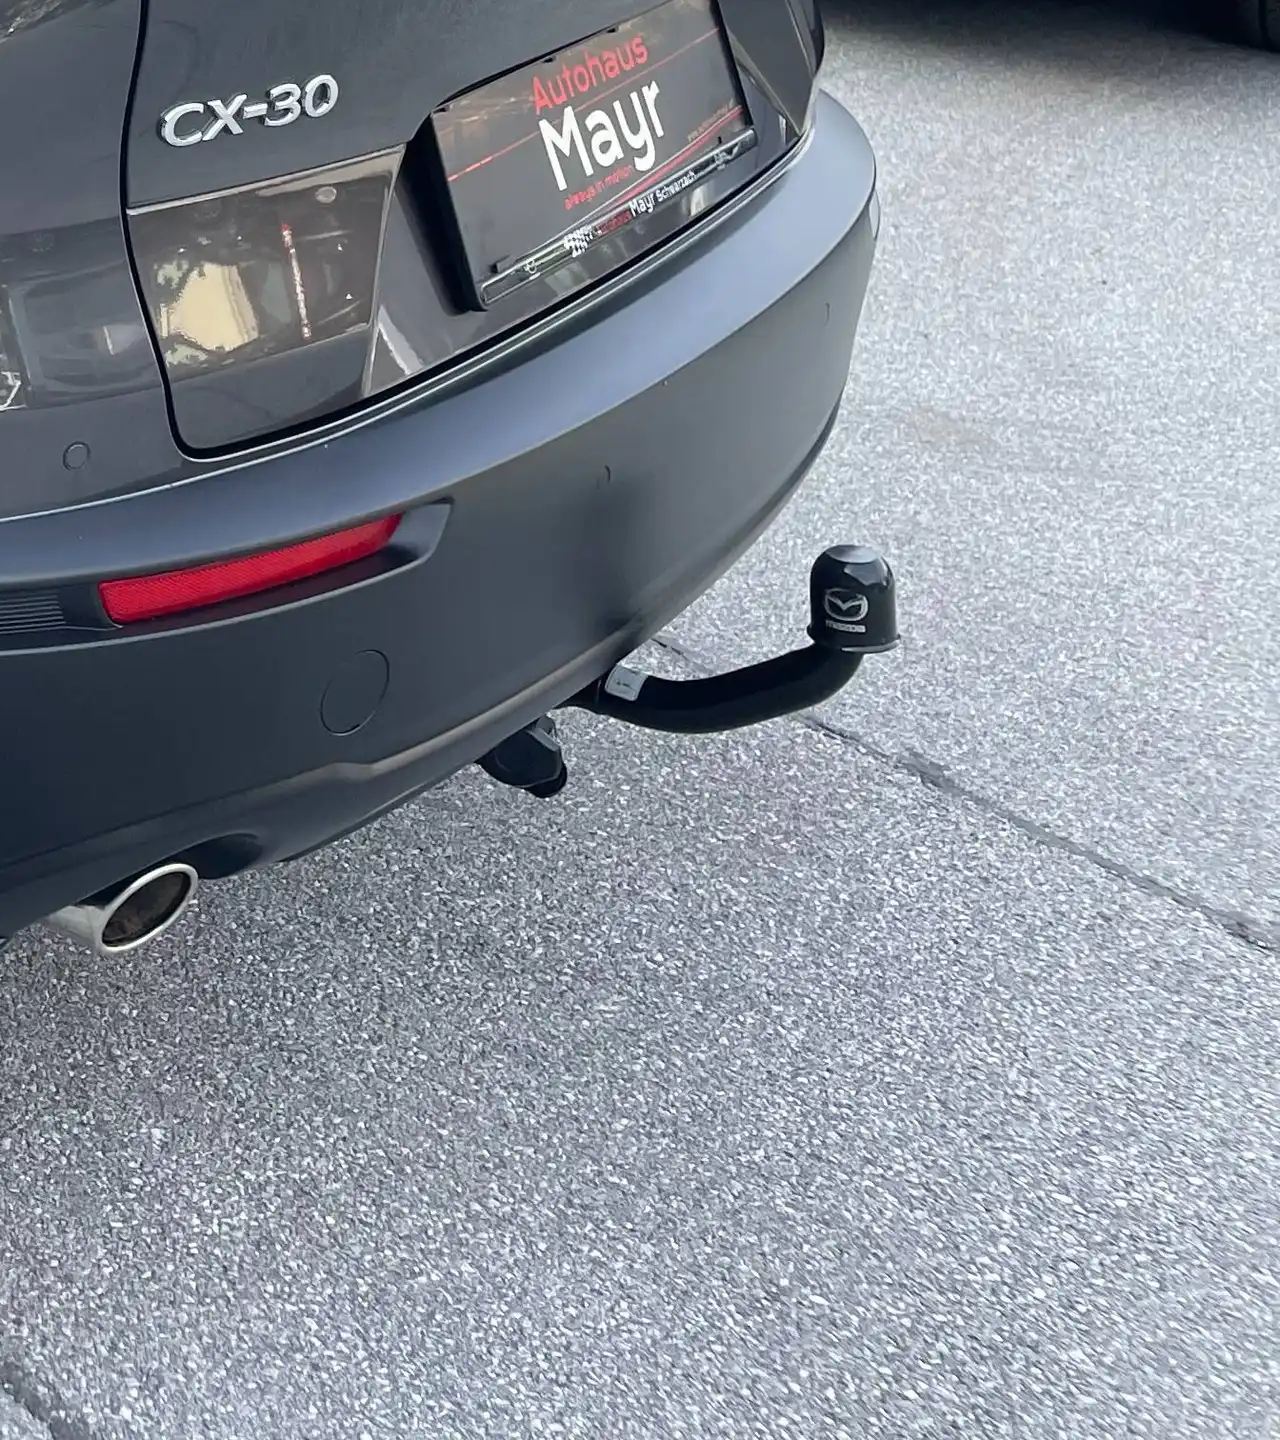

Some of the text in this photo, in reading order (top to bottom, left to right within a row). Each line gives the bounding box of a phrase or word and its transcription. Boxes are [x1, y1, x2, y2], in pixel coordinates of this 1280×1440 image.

[158, 73, 340, 148] CX-30
[532, 35, 649, 116] Autohaus
[538, 80, 665, 192] Mayr
[629, 191, 657, 218] Mayr
[655, 169, 698, 203] Schwarzach
